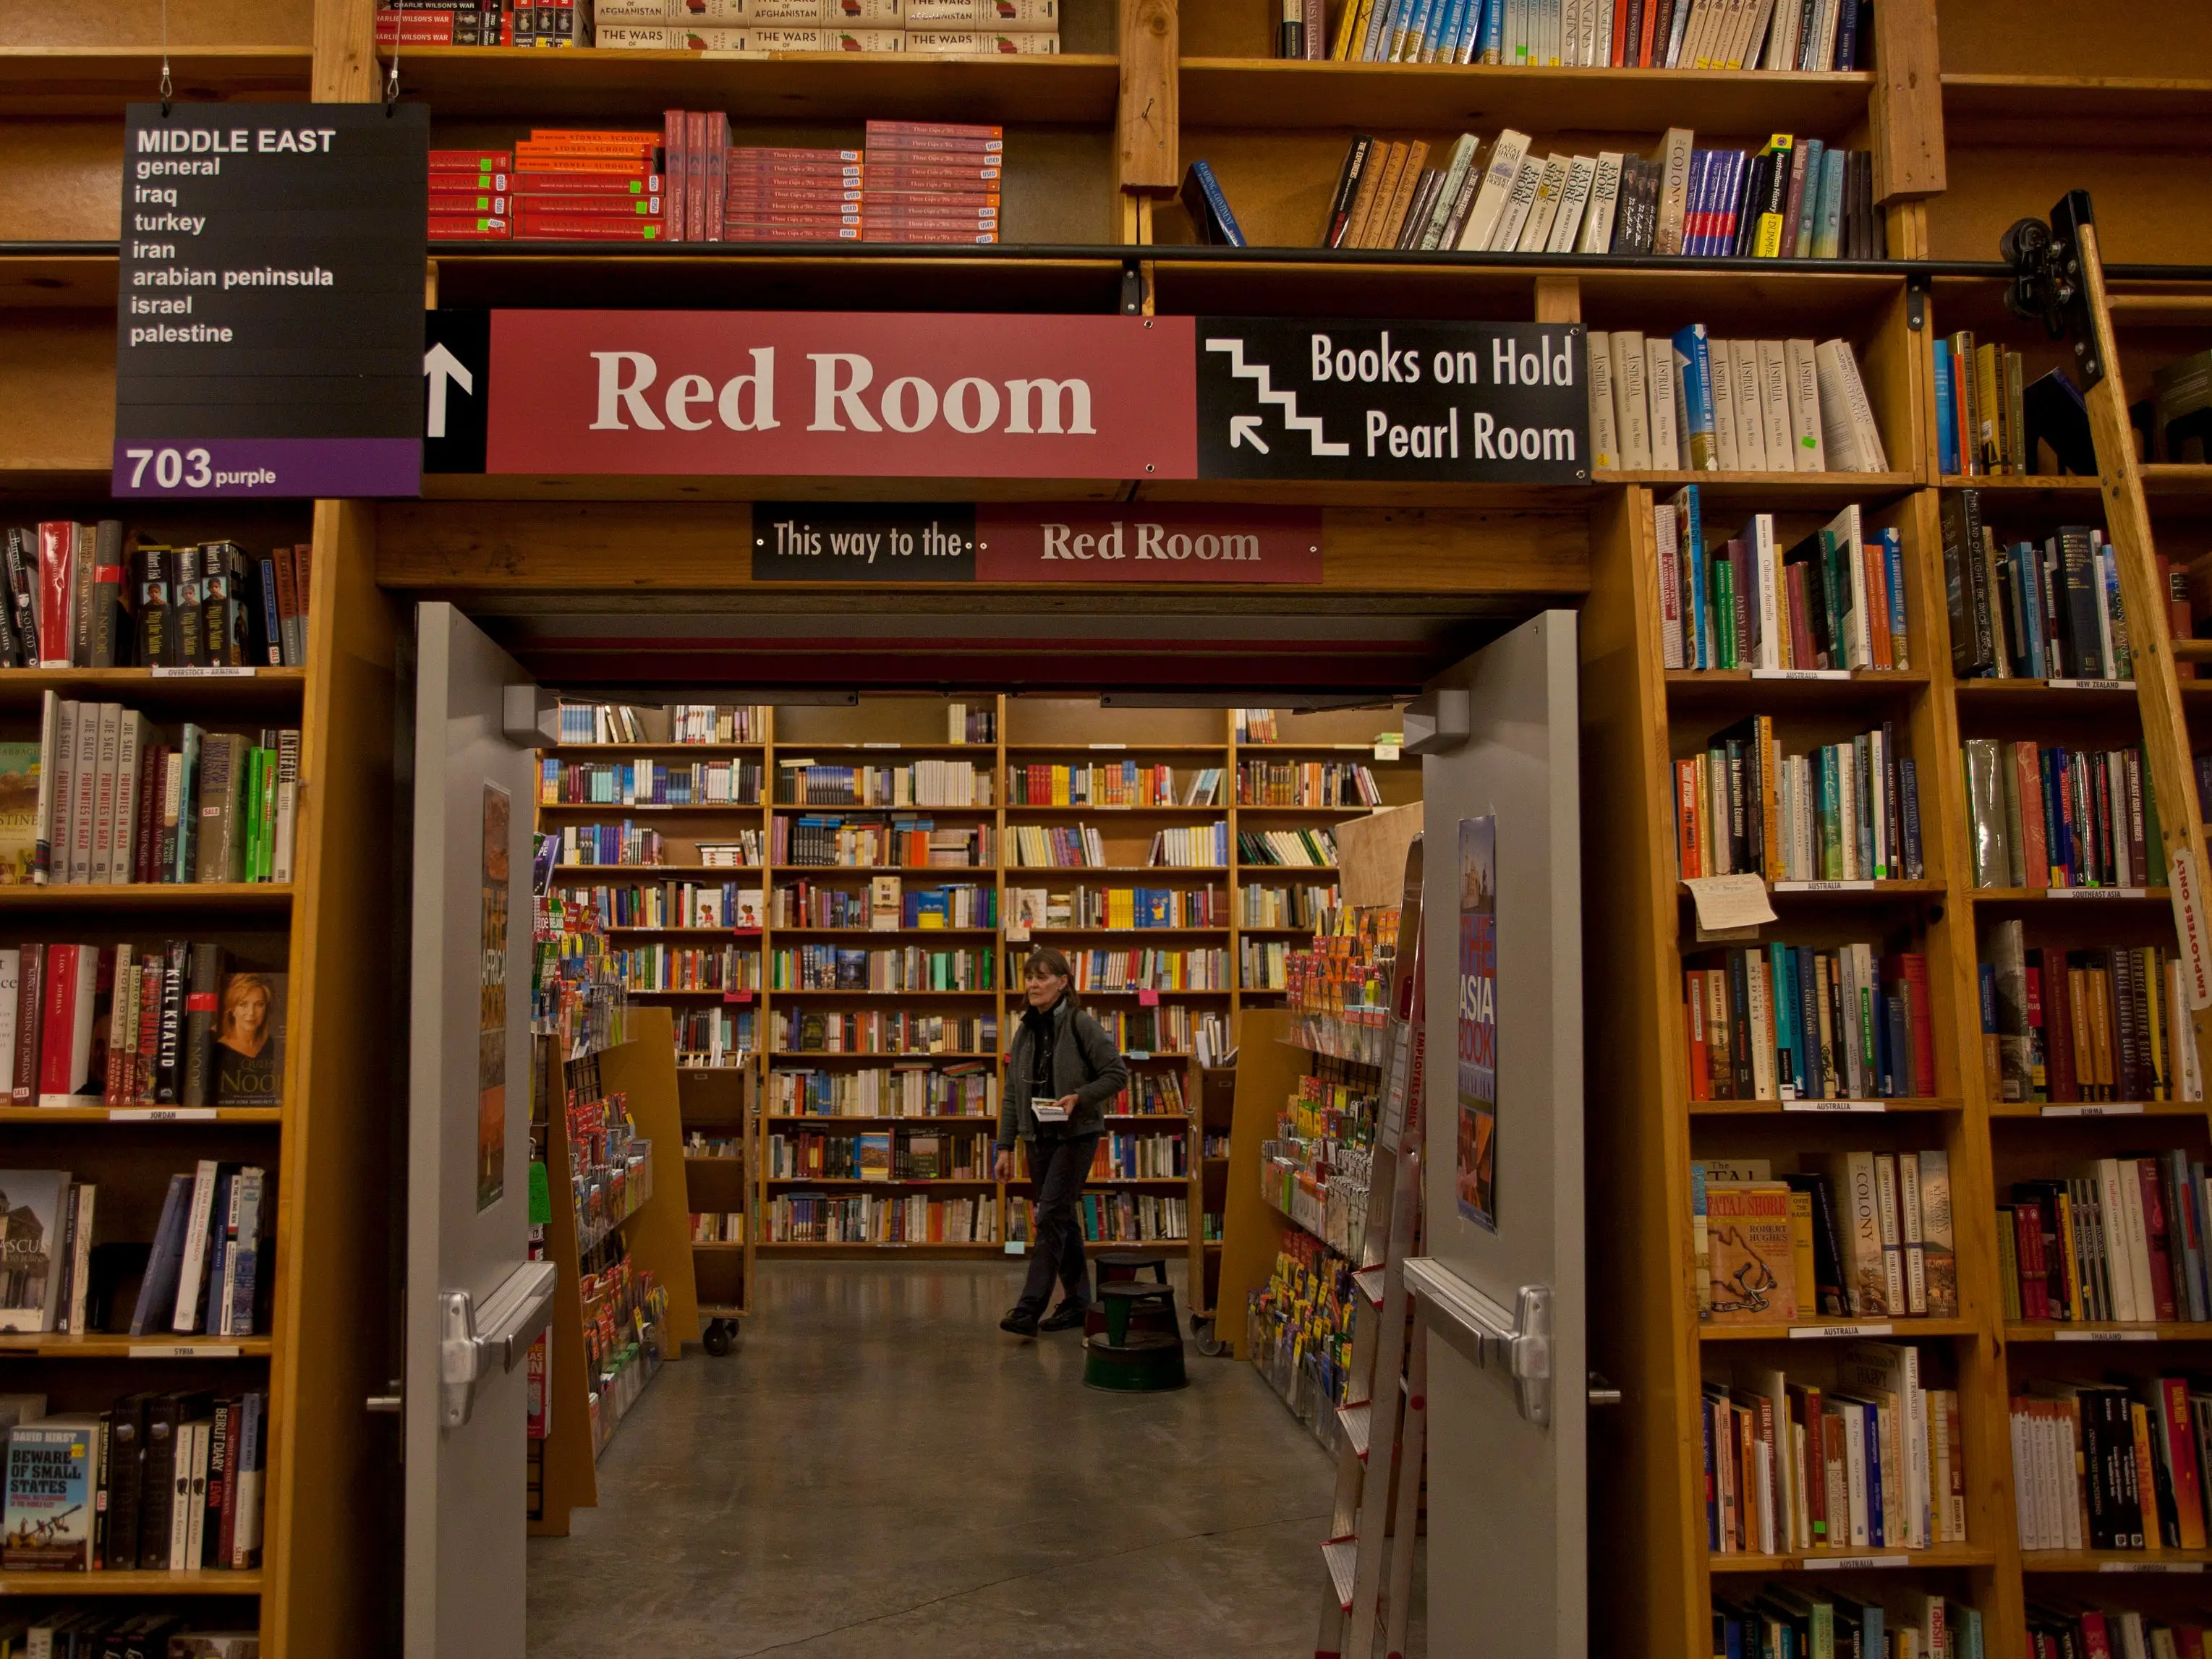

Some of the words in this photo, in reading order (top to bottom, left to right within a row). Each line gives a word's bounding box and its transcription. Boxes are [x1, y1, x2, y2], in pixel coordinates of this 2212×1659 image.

[754, 10, 818, 19] AFGHANISTAN
[603, 30, 626, 40] THE
[631, 30, 663, 41] WARS
[756, 31, 780, 42] THE
[784, 32, 817, 43] WARS
[912, 35, 932, 44] THE
[937, 35, 973, 44] WARS
[1308, 25, 1317, 57] BATES
[137, 129, 249, 153] MIDDLE
[258, 129, 336, 153] EAST
[137, 158, 220, 179] general
[841, 151, 856, 160] USED
[1773, 152, 1785, 186] Australian
[1509, 163, 1532, 207] SHORE
[1518, 171, 1540, 208] FATAL
[1562, 162, 1583, 205] SHORE
[1571, 169, 1591, 206] FATAL
[1594, 161, 1609, 203] SHORE
[1604, 166, 1619, 205] FATAL
[1669, 147, 1685, 208] COLONY
[135, 186, 177, 207] iraq
[1769, 187, 1781, 213] History
[135, 213, 205, 235] turkey
[490, 219, 503, 228] USED
[133, 241, 175, 258] iran
[977, 235, 992, 244] USED
[133, 268, 216, 286] arabian
[224, 265, 333, 289] peninsula
[131, 296, 192, 315] israel
[131, 323, 233, 346] palestine
[1311, 330, 1421, 384] Books
[1434, 351, 1477, 385] on
[1492, 335, 1573, 386] Hold
[589, 346, 780, 432] Red
[806, 352, 1097, 435] Room
[1366, 406, 1458, 459] Pearl
[1474, 412, 1576, 461] Room
[127, 448, 212, 488] 703
[216, 469, 276, 487] purple
[1968, 496, 1977, 513] THIS
[773, 521, 822, 556] This
[830, 530, 880, 563] way
[890, 531, 914, 557] to
[922, 522, 961, 557] the
[1040, 521, 1126, 560] Red
[1135, 523, 1262, 561] Room
[1969, 519, 1978, 538] LAND
[1736, 595, 1745, 627] DAISY
[22, 610, 35, 648] SQUAD
[1737, 628, 1748, 663] BATES
[61, 717, 72, 733] JOE
[104, 720, 114, 733] JOE
[124, 723, 134, 735] JOE
[60, 735, 71, 759] SACCO
[103, 736, 114, 762] SACCO
[122, 738, 133, 762] SACCO
[280, 734, 298, 784] INTIFADA
[56, 771, 69, 814] FOOTNOTES
[1732, 768, 1743, 806] Australian
[2129, 761, 2140, 797] SOUTHEAST
[100, 773, 111, 816] FOOTNOTES
[119, 773, 131, 816] FOOTNOTES
[1733, 808, 1744, 837] Economy
[54, 826, 66, 848] GAZA
[97, 830, 109, 850] GAZA
[117, 829, 128, 849] GAZA
[2176, 858, 2189, 901] ONLY
[1460, 916, 1495, 978] THE
[2185, 904, 2206, 999] EMPLOYEES
[480, 947, 505, 988] AFRICA
[164, 968, 180, 1003] KILL
[1458, 973, 1494, 1025] ASIA
[25, 989, 35, 1031] HUSSEIN
[25, 1032, 32, 1046] OF
[161, 1010, 179, 1067] KHALID
[1458, 1016, 1494, 1068] BOOK
[22, 1048, 31, 1083] JORDAN
[1411, 1031, 1425, 1096] EMPLOYEES
[14, 1088, 28, 1096] SALE
[1408, 1097, 1418, 1127] ONLY
[1816, 1102, 1851, 1111] AUSTRALIA
[1706, 1195, 1745, 1216] FATAL
[1748, 1195, 1787, 1216] SHORE
[1855, 1172, 1874, 1242] COLONY
[1749, 1225, 1787, 1234] ROBERT
[1824, 1326, 1858, 1335] AUSTRALIA
[2090, 1332, 2122, 1341] THAILAND
[1910, 1355, 1918, 1380] HAPPY
[215, 1407, 228, 1441] BEIRUT
[1761, 1404, 1772, 1428] TERRA
[12, 1431, 42, 1443] DAVID
[45, 1432, 77, 1443] HIRST
[12, 1450, 72, 1464] BEWARE
[211, 1442, 226, 1472] DIARY
[11, 1465, 29, 1479] OF
[32, 1466, 82, 1480] SMALL
[10, 1480, 67, 1494] STATES
[98, 1491, 106, 1509] SALE
[208, 1480, 221, 1508] LEVIN
[1839, 1558, 1874, 1569] AUSTRALIA
[1932, 1605, 1944, 1648] racism
